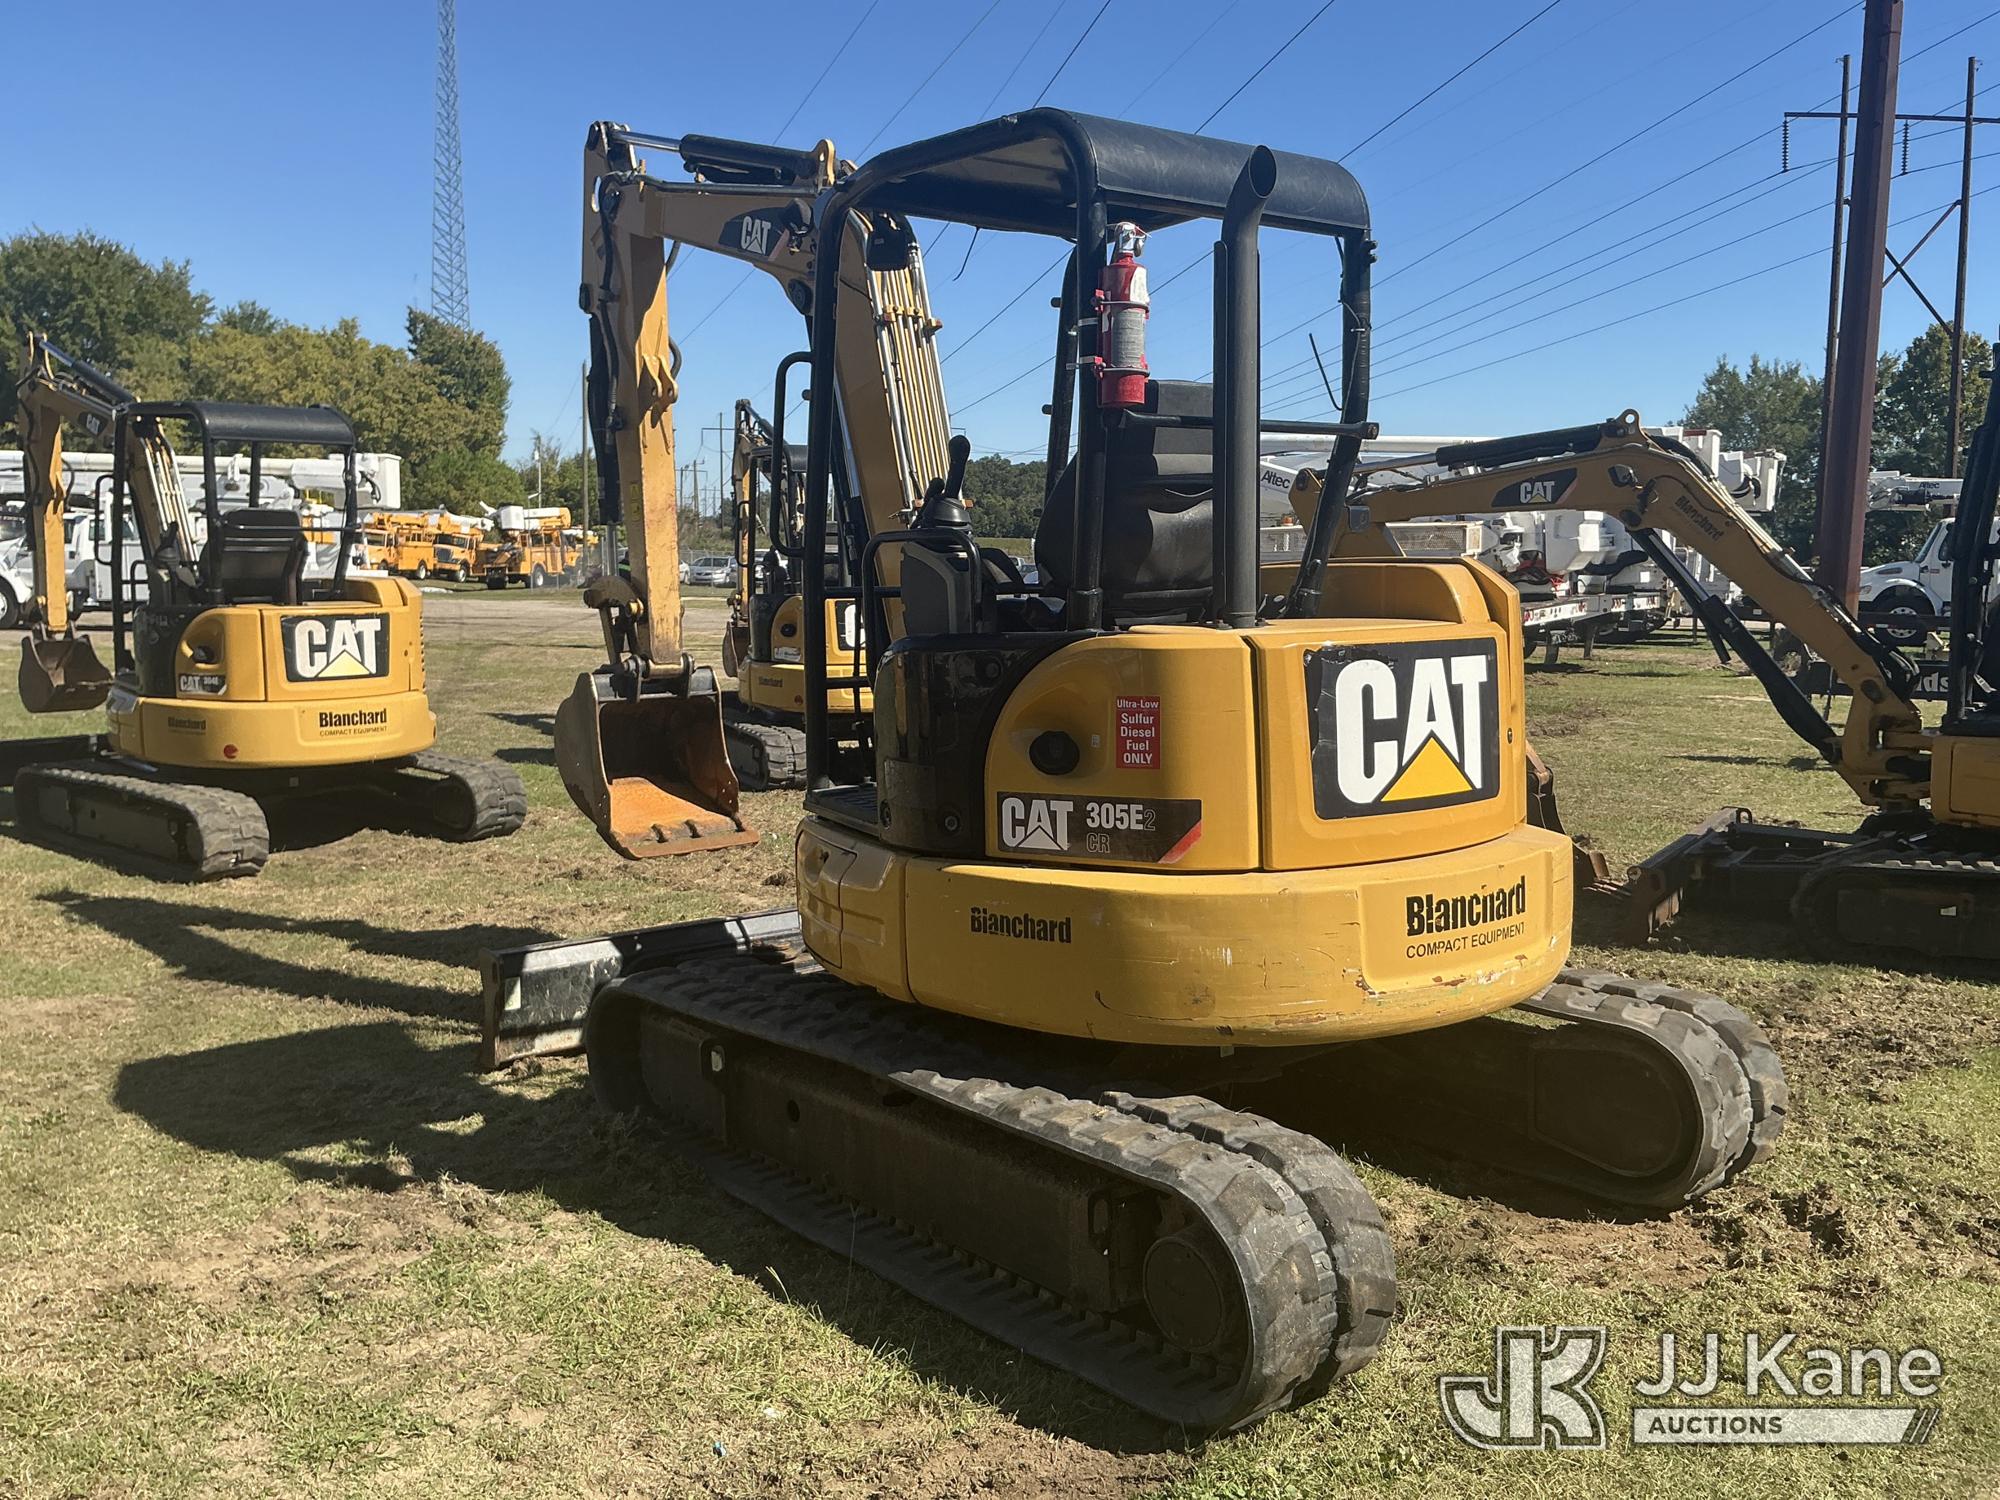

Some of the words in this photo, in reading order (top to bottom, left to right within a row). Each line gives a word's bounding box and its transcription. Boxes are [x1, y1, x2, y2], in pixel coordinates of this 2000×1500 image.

[741, 216, 771, 254] CAT
[1261, 470, 1290, 488] Altec
[1520, 481, 1555, 503] CAT
[295, 618, 381, 678] CAT
[180, 675, 200, 691] CAT
[1117, 699, 1159, 709] Ultra-Low
[319, 708, 387, 728] Blanchard
[1121, 712, 1154, 724] Sulfur
[319, 728, 352, 738] COMPACT
[1120, 726, 1155, 737] Diesel
[1336, 655, 1487, 804] CAT
[1126, 739, 1149, 751] Fuel
[1123, 752, 1152, 764] ONLY
[1002, 797, 1074, 851] CAT
[1086, 833, 1110, 853] CR
[1406, 875, 1525, 937] Blanchard
[970, 906, 1072, 944] Blanchard
[1406, 936, 1469, 959] COMPACT
[1471, 921, 1525, 948] EQUIPMENT
